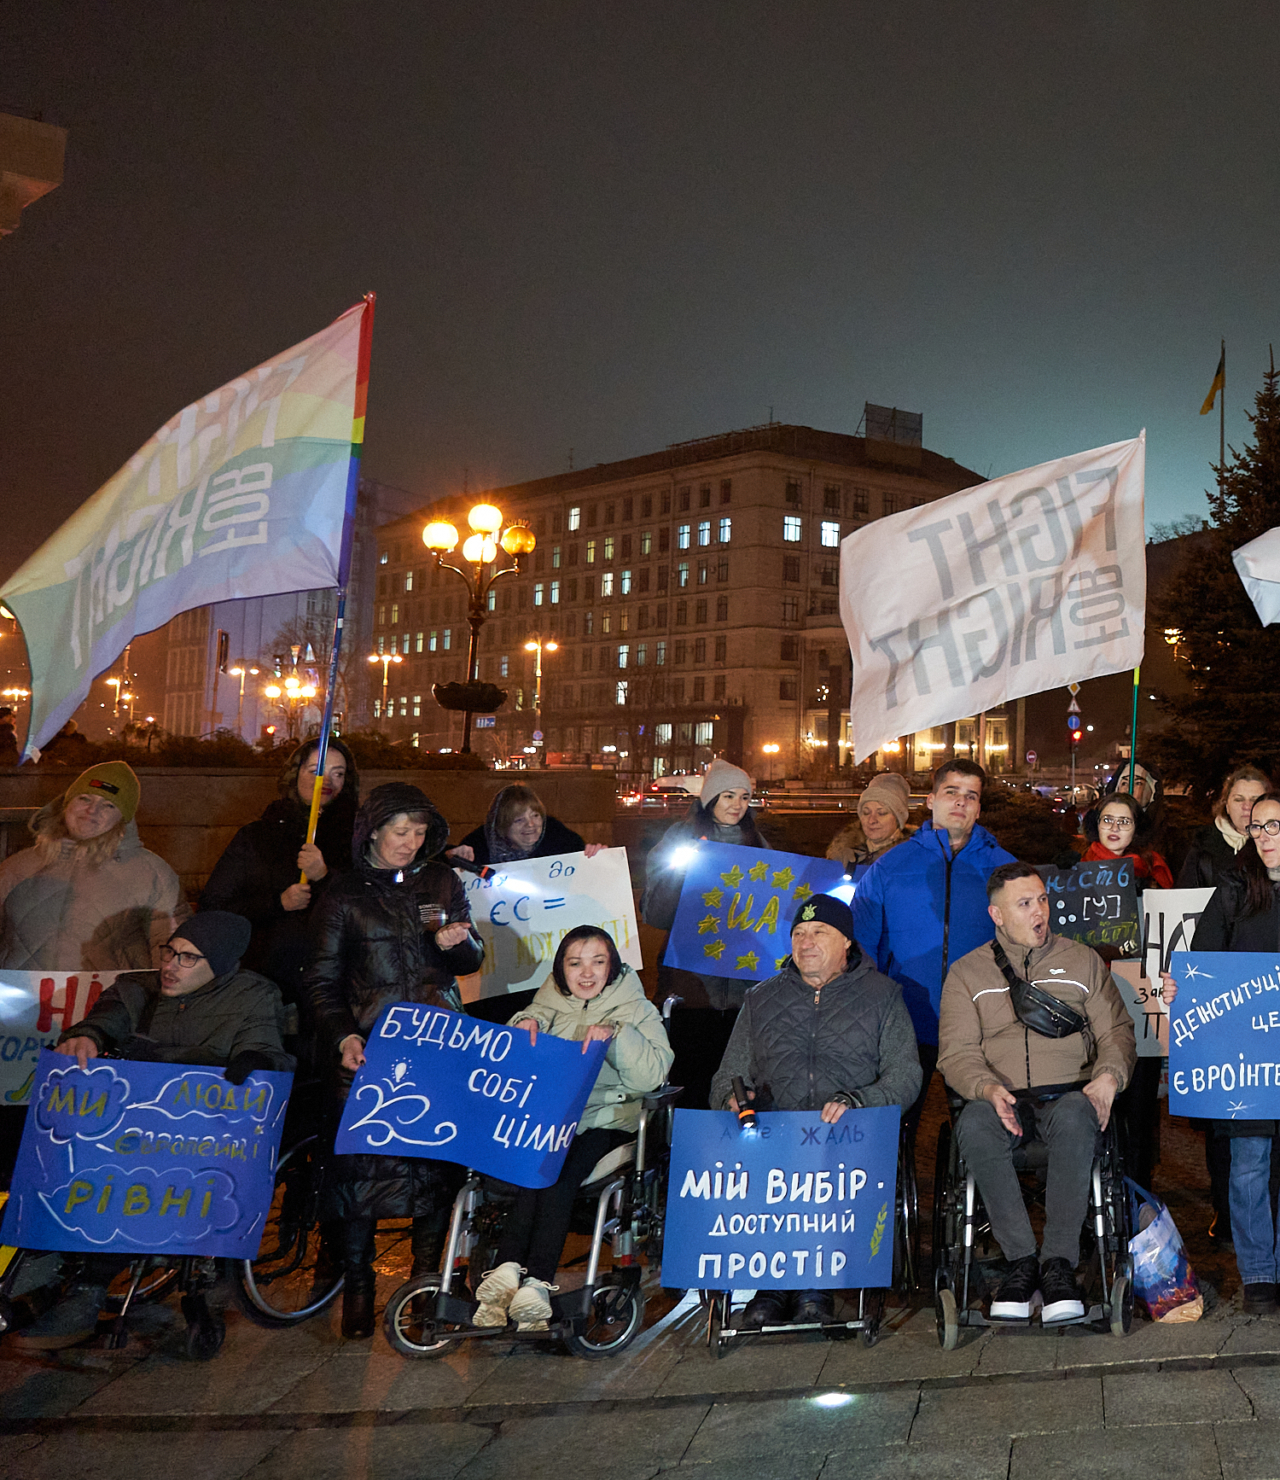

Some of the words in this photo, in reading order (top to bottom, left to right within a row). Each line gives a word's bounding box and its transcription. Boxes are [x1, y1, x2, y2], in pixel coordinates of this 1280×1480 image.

[490, 895, 531, 926] ЄС
[727, 892, 780, 935] UA
[380, 1006, 513, 1063] БУДЬМО
[47, 1087, 109, 1118] МИ
[173, 1080, 267, 1113] ЛЮДИ
[468, 1067, 538, 1109] СОБІ
[680, 1161, 750, 1200] МІЙ
[708, 1208, 856, 1237] ДОСТУПНИЙ
[698, 1245, 848, 1280] ПРОСТІР
